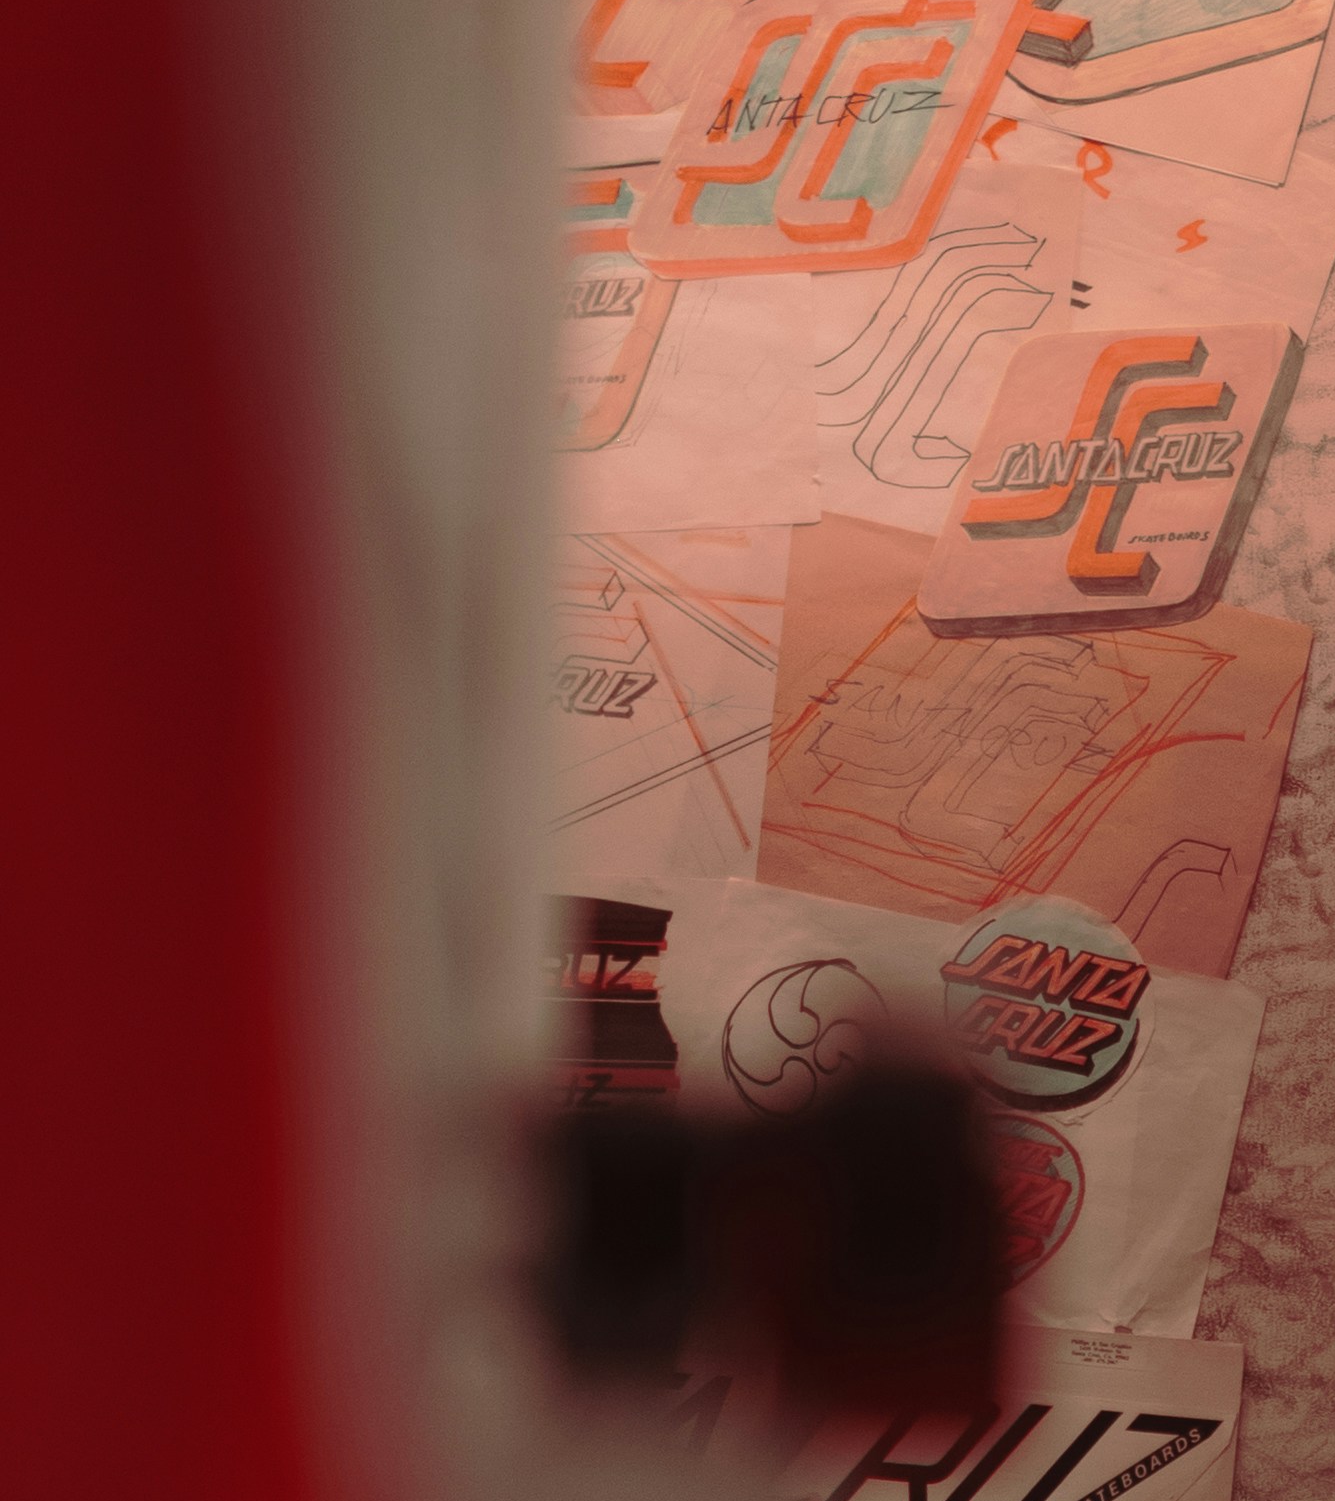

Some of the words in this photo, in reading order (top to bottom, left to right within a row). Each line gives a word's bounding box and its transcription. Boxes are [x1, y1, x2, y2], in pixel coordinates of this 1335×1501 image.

[816, 88, 956, 128] CRUZ
[570, 277, 645, 319] RUZ
[972, 438, 1126, 492] SANTA
[1125, 431, 1244, 483] CRUZ
[556, 666, 659, 719] RUZ
[940, 934, 1152, 1021] SANTA
[950, 995, 1124, 1077] CRUZ
